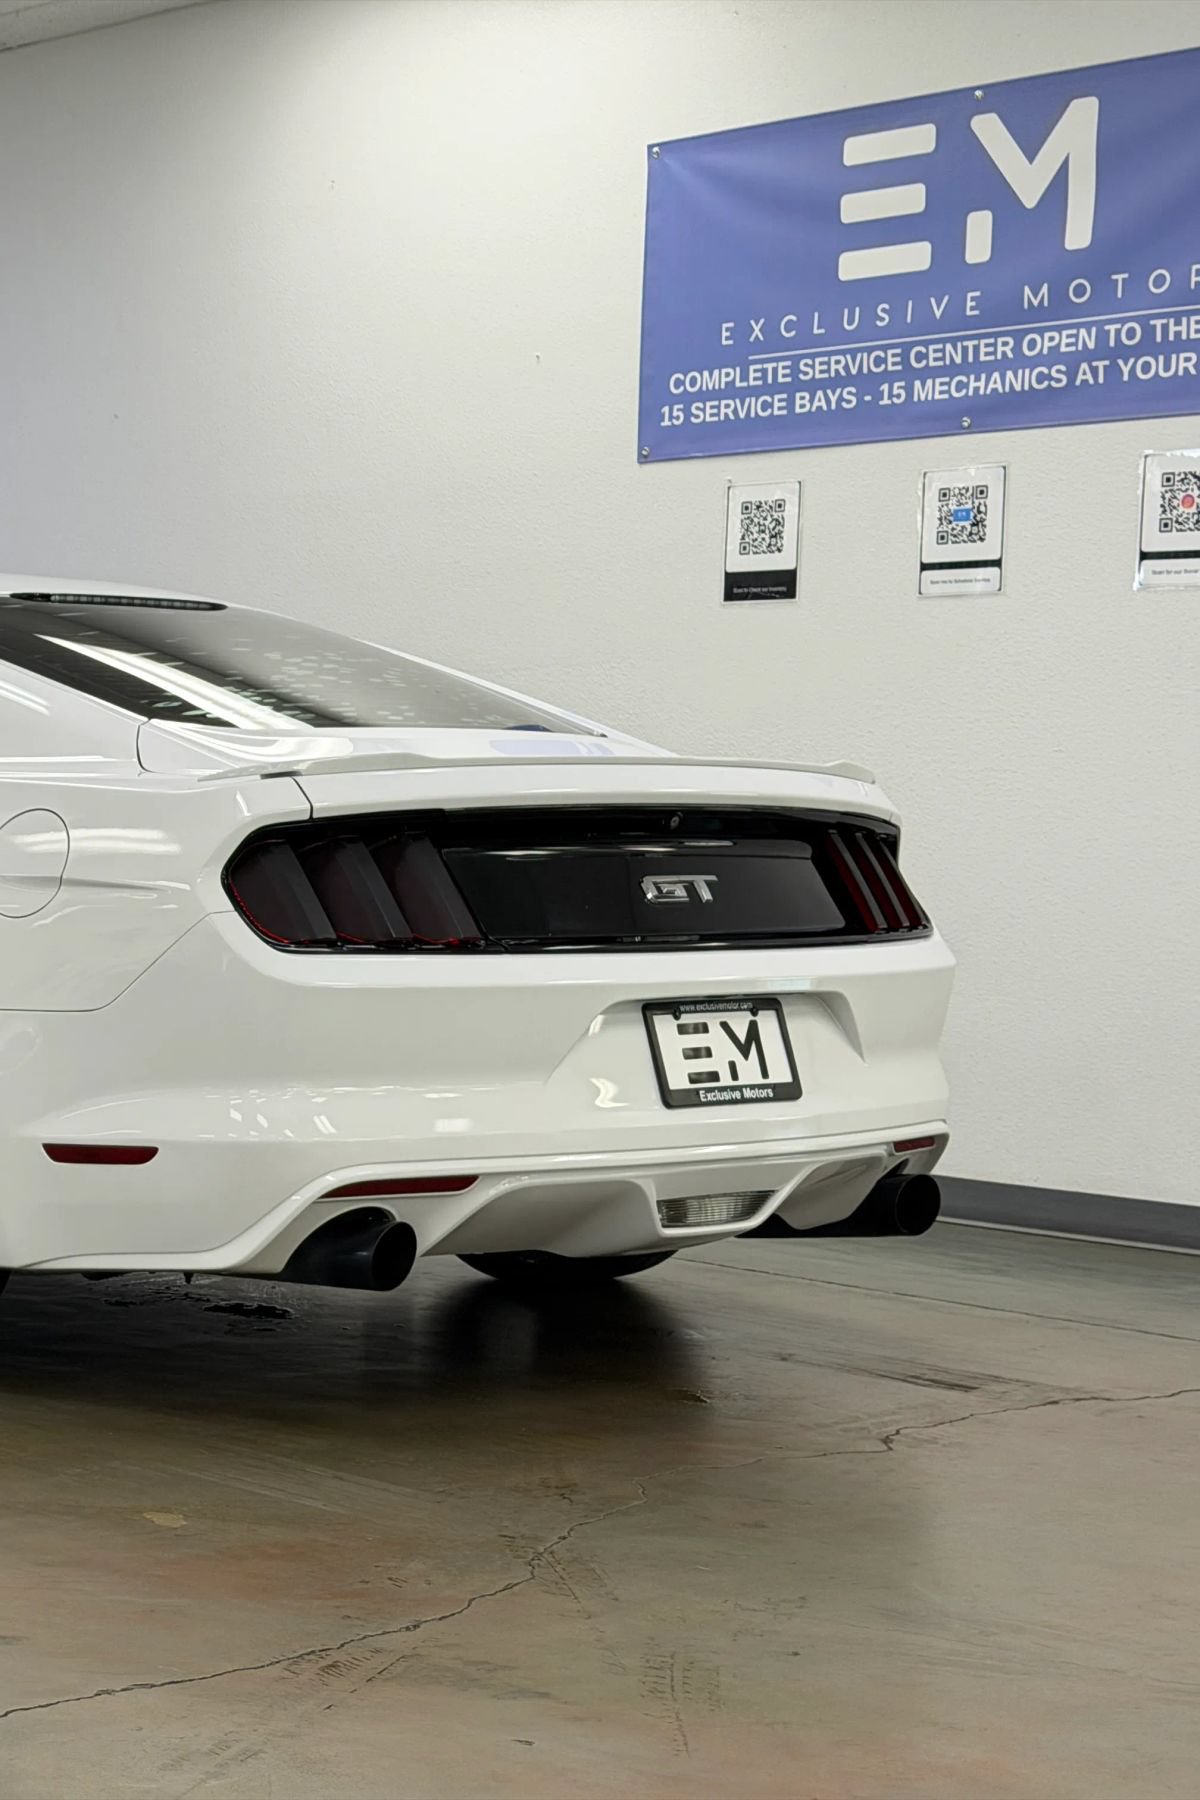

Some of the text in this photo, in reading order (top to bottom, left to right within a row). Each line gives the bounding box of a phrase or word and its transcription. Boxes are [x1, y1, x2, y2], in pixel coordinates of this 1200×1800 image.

[838, 96, 1099, 281] EM
[721, 291, 981, 345] EXCLUSIVE
[669, 315, 1200, 394] COMPLETE SERVICE CENTER OPEN TO THE
[660, 404, 684, 426] 15
[690, 394, 788, 423] SERVICE
[795, 386, 857, 414] BAYS
[878, 381, 906, 405] 15
[913, 364, 1068, 402] MECHANICS
[1075, 360, 1110, 386] AT
[1117, 352, 1198, 382] YOUR
[640, 874, 719, 903] GT
[676, 1019, 770, 1085] EM
[699, 1088, 773, 1102] Exclusive Motors
